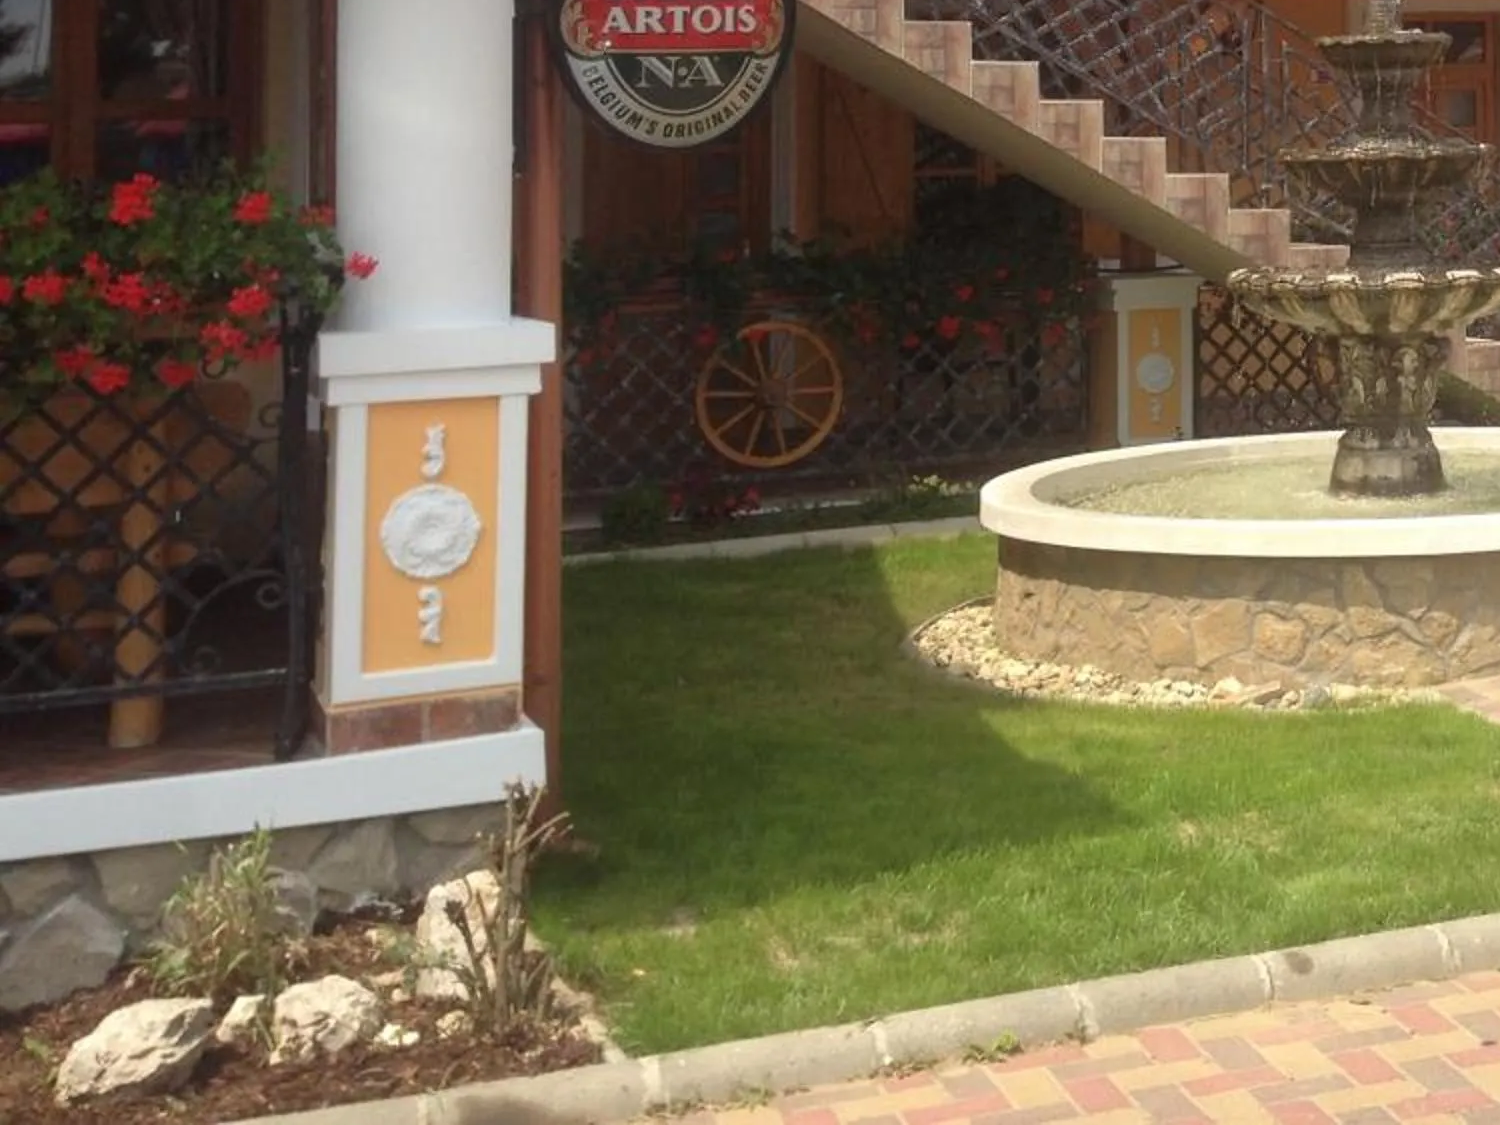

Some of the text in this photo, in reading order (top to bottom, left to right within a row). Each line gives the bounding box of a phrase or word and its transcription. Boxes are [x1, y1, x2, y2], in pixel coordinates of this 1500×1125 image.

[602, 6, 757, 34] ARTOIS
[582, 60, 769, 138] BELGIUM'S ORIGINAL BEER
